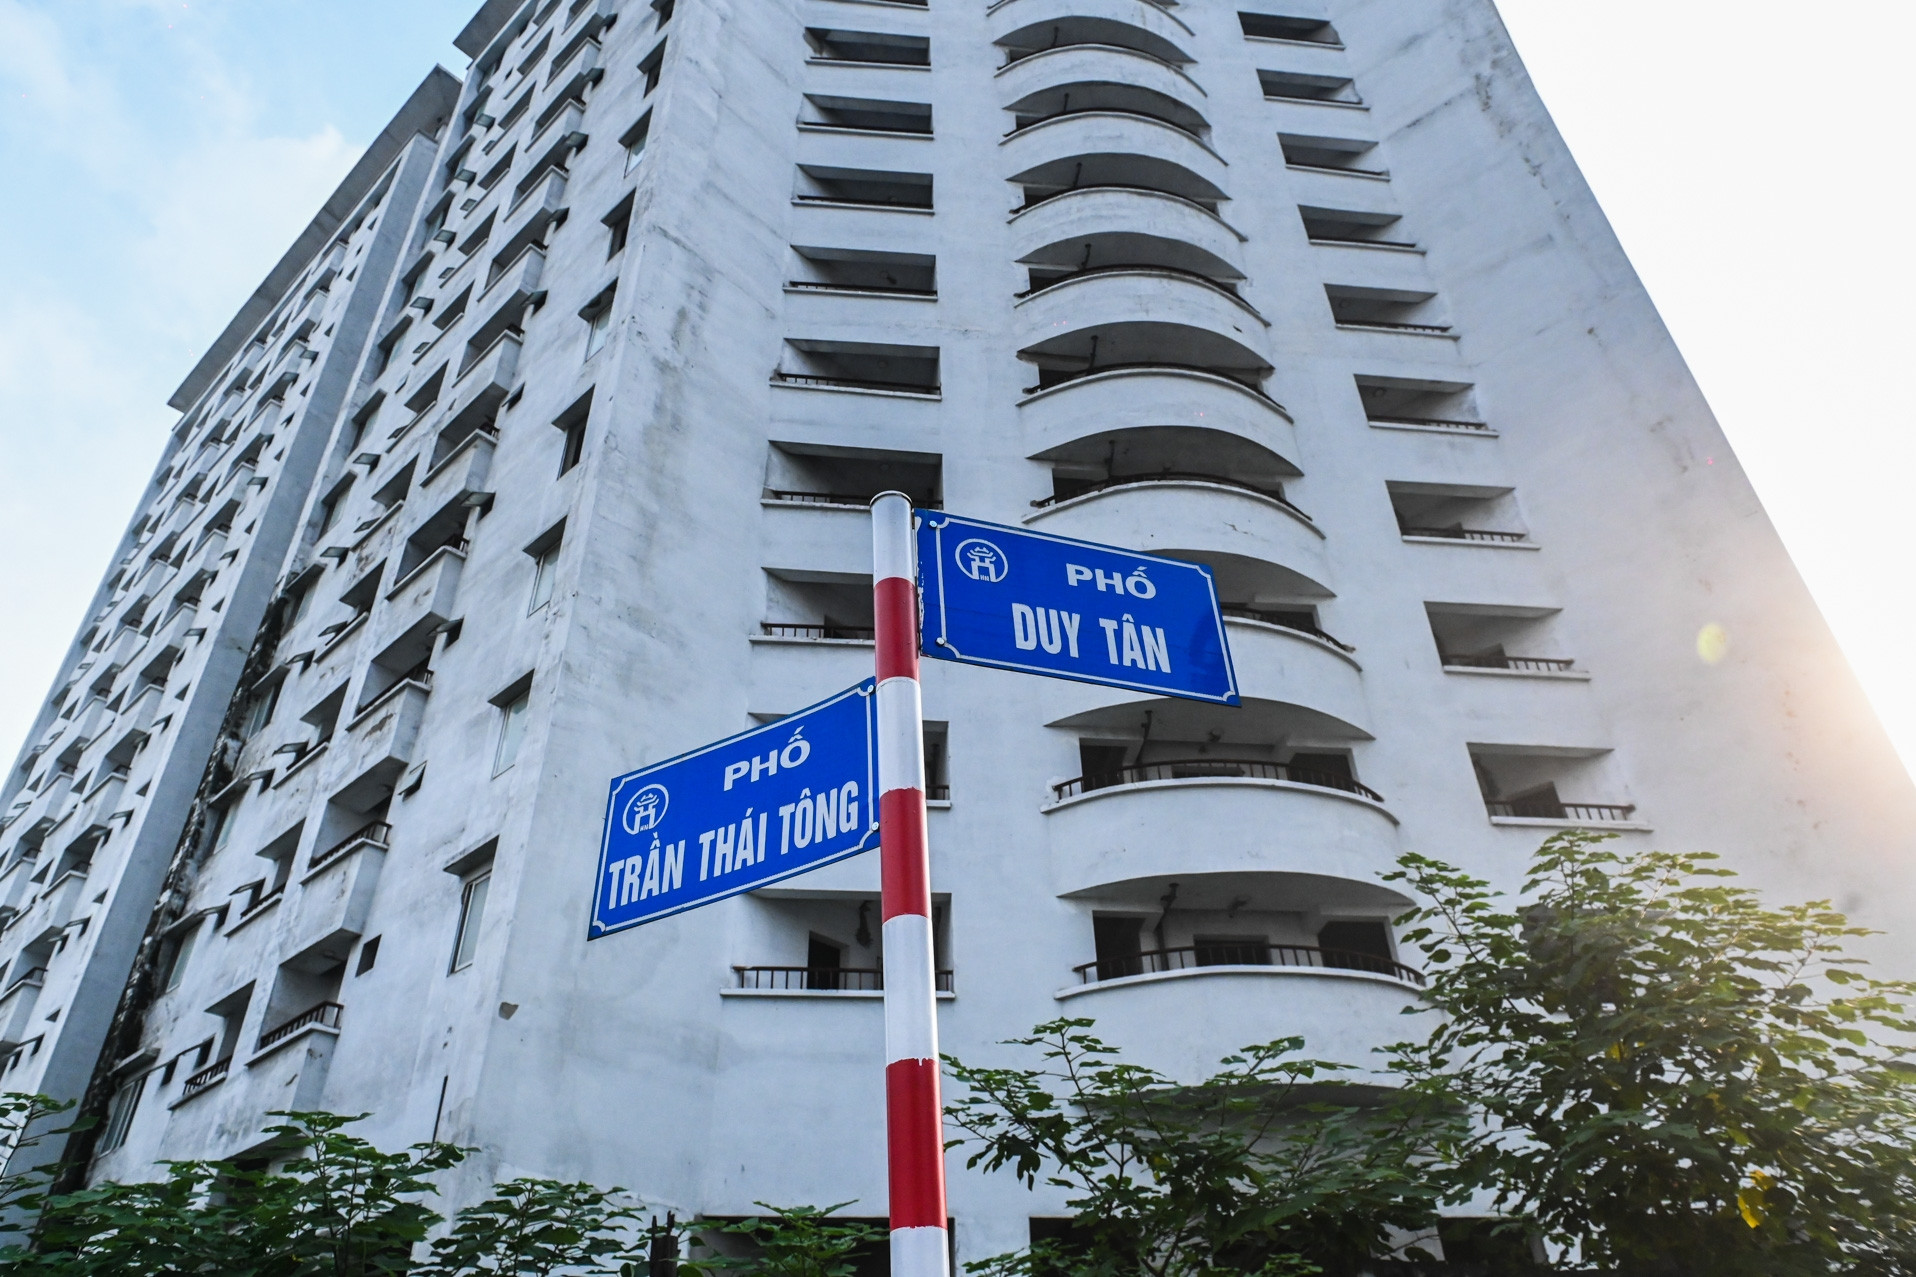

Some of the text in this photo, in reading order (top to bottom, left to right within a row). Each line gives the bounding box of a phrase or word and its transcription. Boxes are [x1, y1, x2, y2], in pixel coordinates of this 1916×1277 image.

[1066, 564, 1155, 598] PHỐ
[1011, 603, 1171, 674] DUY TÂN
[724, 726, 810, 792] PHỐ
[609, 781, 858, 909] TRẦN THÁI TÔNG
